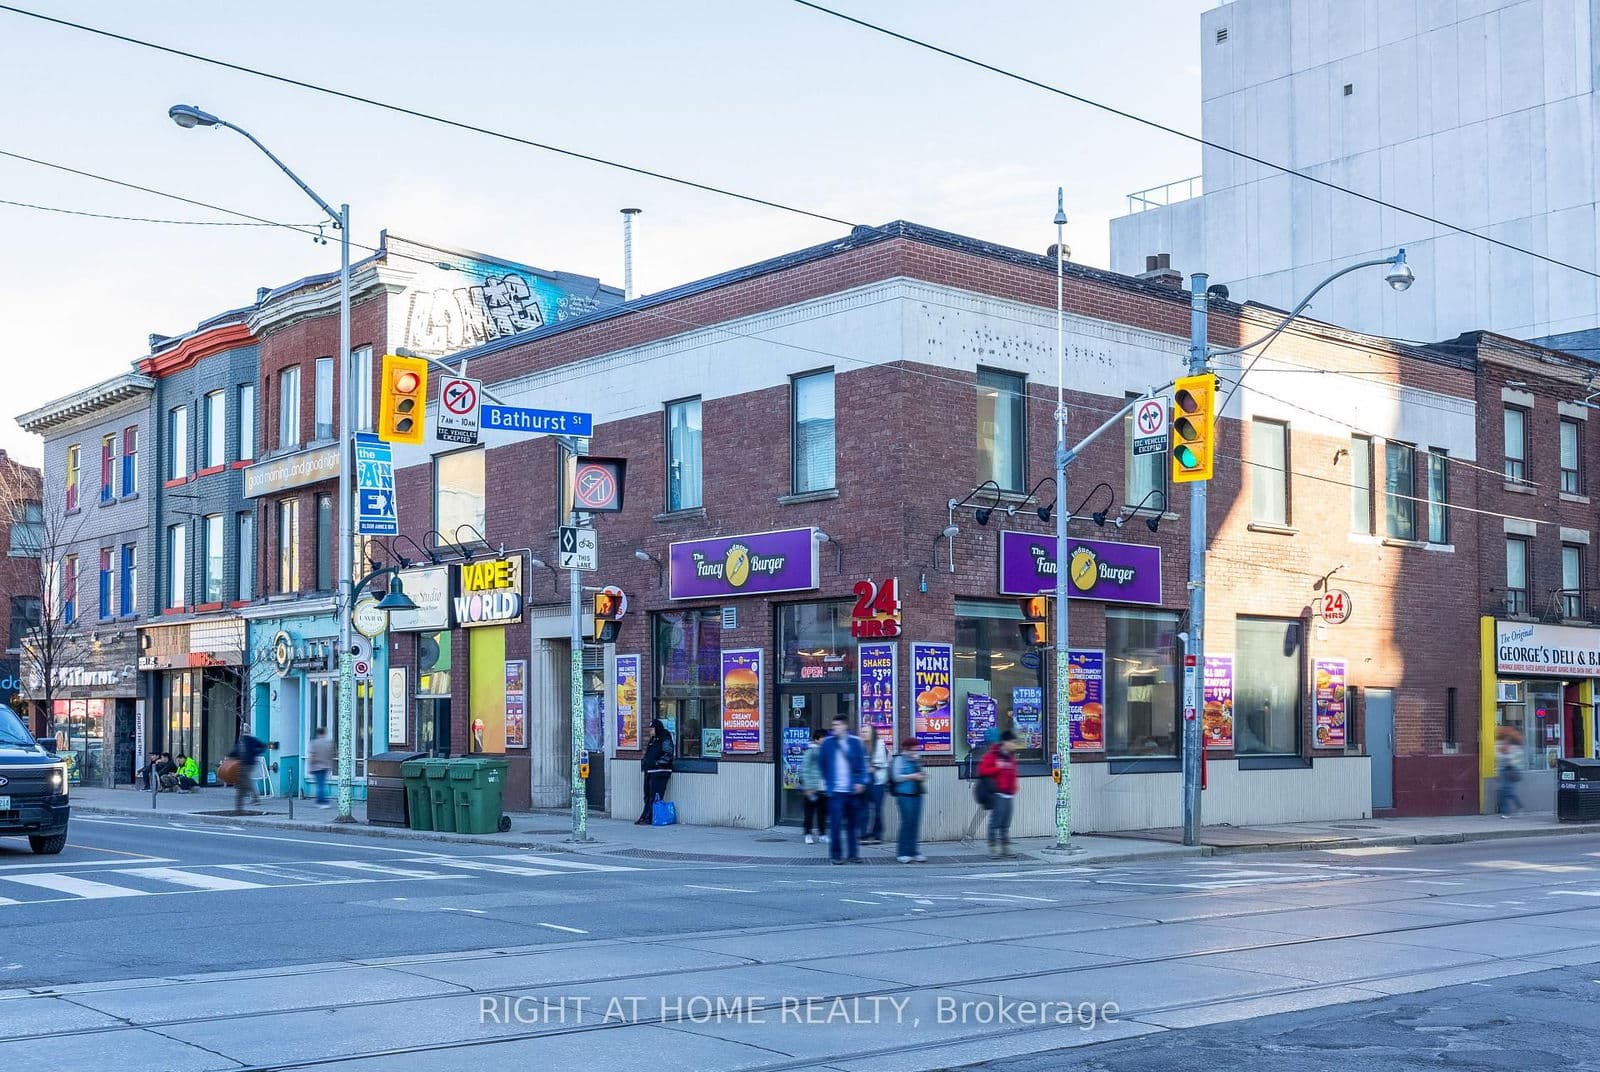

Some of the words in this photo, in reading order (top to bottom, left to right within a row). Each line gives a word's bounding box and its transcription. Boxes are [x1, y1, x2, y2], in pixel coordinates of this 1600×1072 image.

[440, 415, 454, 424] 7AM
[461, 418, 476, 427] 10AM
[491, 409, 566, 430] Bathurst
[572, 415, 582, 425] St
[443, 434, 471, 443] EXCEPTED
[359, 448, 376, 459] the
[248, 473, 264, 490] good
[306, 455, 323, 476] good
[578, 554, 591, 562] THIS
[693, 553, 704, 561] The
[1031, 547, 1045, 556] The
[697, 561, 724, 579] Fancy
[750, 555, 785, 575] Burger
[1036, 557, 1057, 574] Fan
[1098, 562, 1135, 584] Burger
[463, 560, 512, 592] VAPE
[852, 577, 900, 618] 24
[1325, 593, 1344, 612] 24
[454, 592, 519, 623] WORLD
[850, 619, 901, 638] HRS
[1500, 633, 1511, 645] The
[1511, 625, 1534, 641] Original
[1499, 645, 1550, 664] GEORGE'S
[1552, 649, 1575, 665] DELI
[1577, 650, 1586, 665] &
[862, 658, 892, 668] SHAKES
[915, 656, 949, 671] MINI
[801, 666, 824, 679] OPEN
[915, 671, 949, 685] TWIN
[1018, 688, 1036, 698] TFIB
[1069, 705, 1084, 714] EGGIE
[731, 713, 752, 721] CREAMY
[724, 720, 760, 729] MUSHROOM
